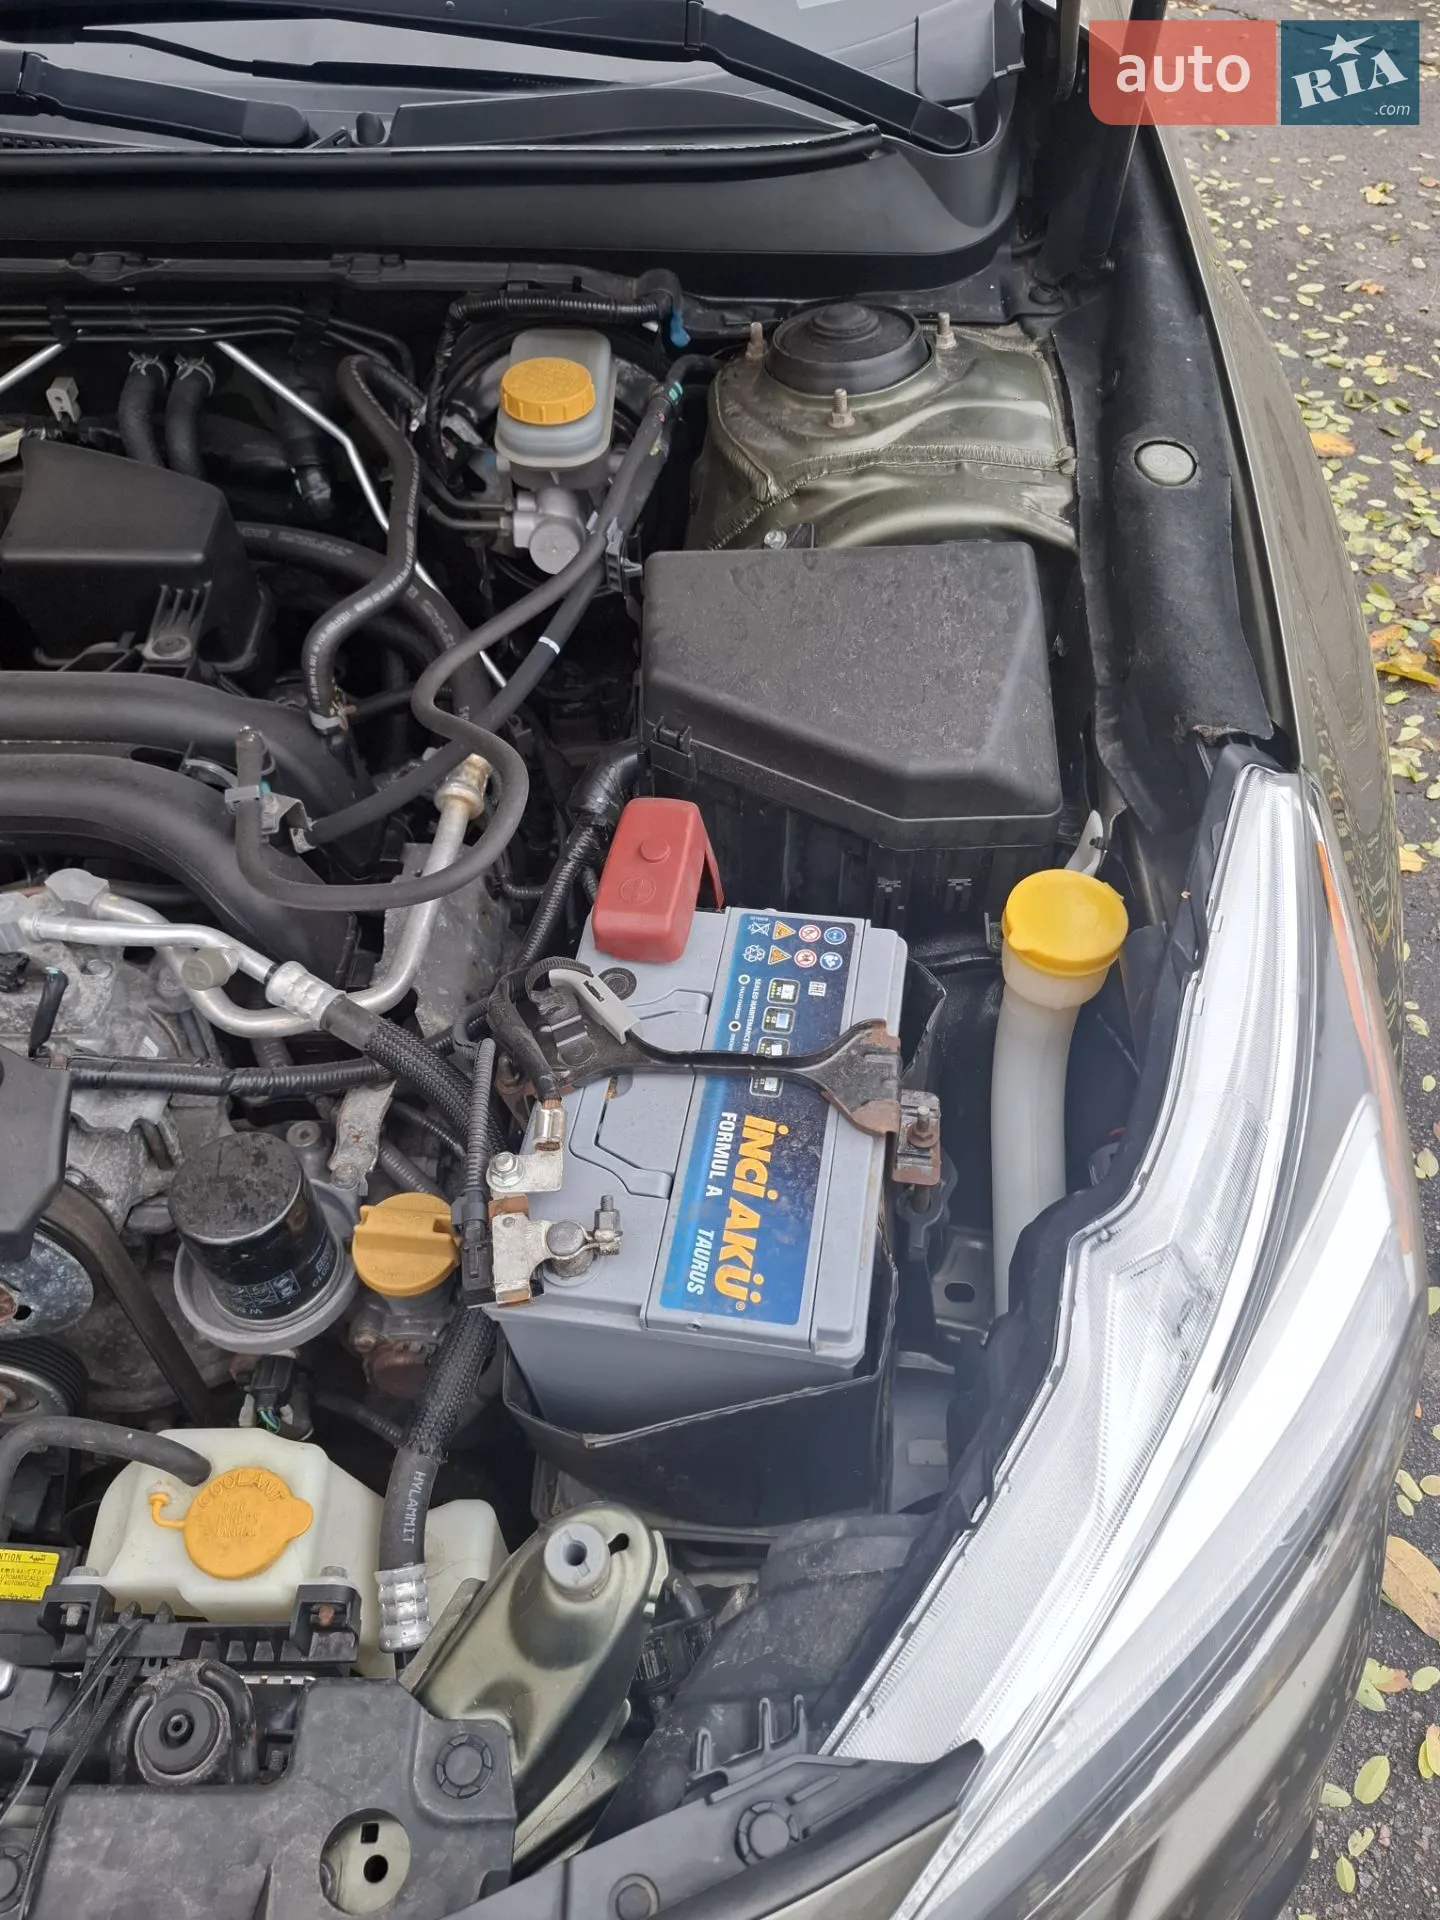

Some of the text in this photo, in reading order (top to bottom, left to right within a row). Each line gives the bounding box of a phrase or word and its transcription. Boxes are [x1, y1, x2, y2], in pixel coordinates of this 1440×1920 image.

[751, 978, 762, 1000] SEALED
[743, 1000, 758, 1043] MAINTENANCE
[705, 1111, 738, 1197] FORMUL A
[686, 1228, 715, 1295] TAURUS
[197, 1472, 288, 1509] COOLANT
[402, 1470, 427, 1545] HYLAMMIT
